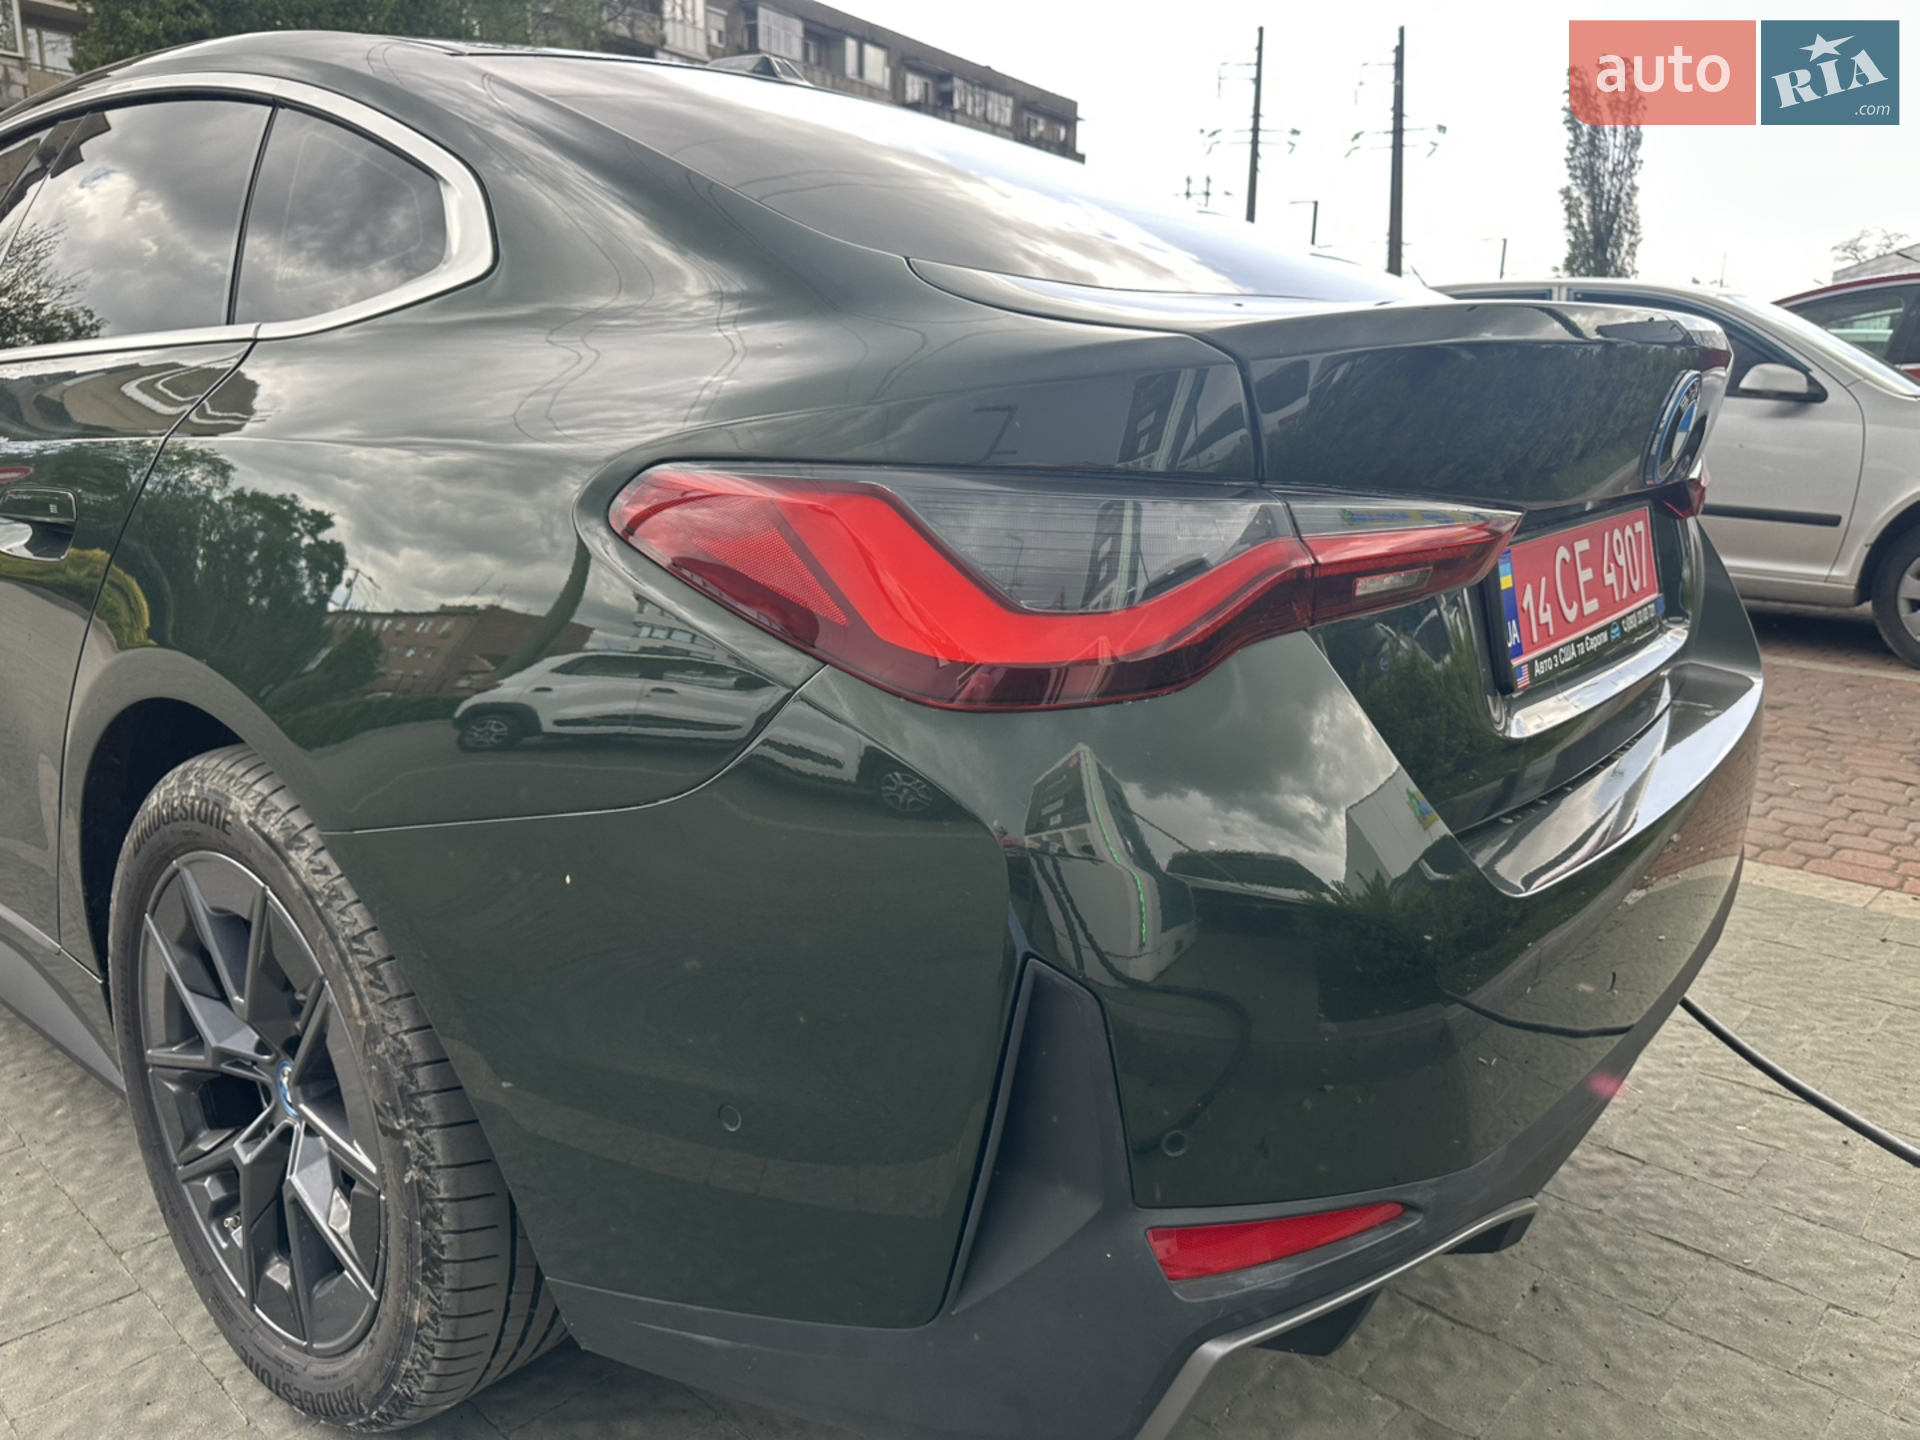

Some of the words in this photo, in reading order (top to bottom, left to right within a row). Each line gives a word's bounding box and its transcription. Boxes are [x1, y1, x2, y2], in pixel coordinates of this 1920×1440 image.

[1522, 576, 1555, 644] 14
[1555, 538, 1600, 624] CE
[1603, 520, 1649, 603] 4907
[1534, 659, 1553, 677] Авто
[1558, 647, 1577, 666] США
[1576, 643, 1585, 657] та
[1585, 631, 1608, 651] Європи
[131, 795, 236, 858] BRIDGESTONE
[239, 1344, 368, 1418] BRIDGESTONE
